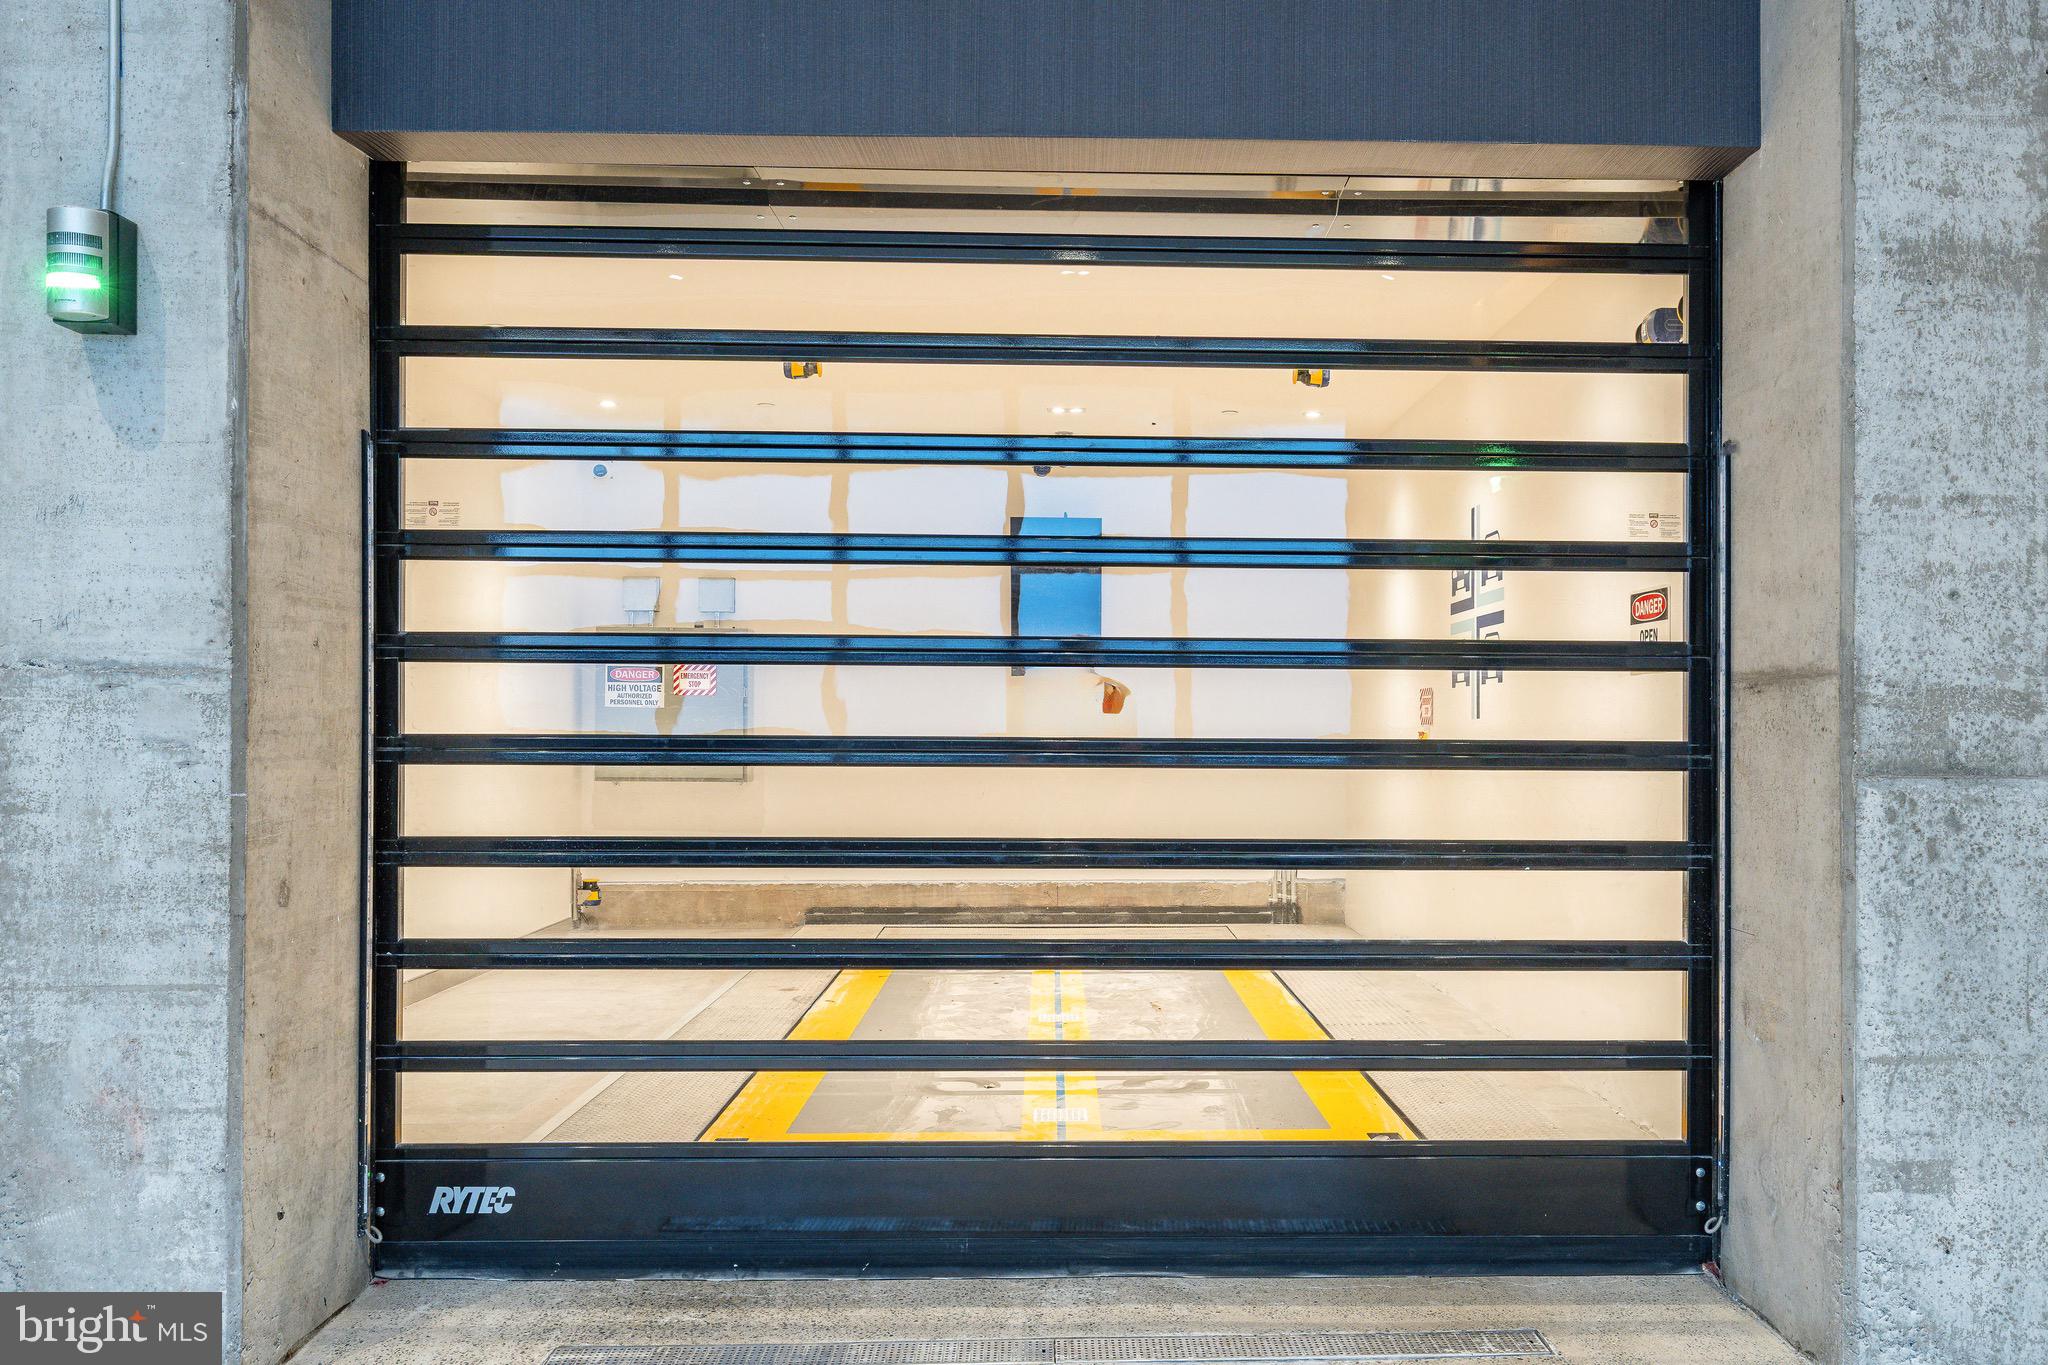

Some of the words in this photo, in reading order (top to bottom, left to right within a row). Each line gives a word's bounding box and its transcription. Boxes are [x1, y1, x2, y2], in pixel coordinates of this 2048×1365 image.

[1635, 598, 1663, 617] DANGER
[1640, 628, 1658, 641] OPEN
[615, 670, 655, 679] DANGER
[680, 672, 709, 680] EMERGENCY
[607, 684, 627, 692] HIGH
[629, 684, 662, 693] VOLTAGE
[428, 1186, 517, 1214] RYTEC
